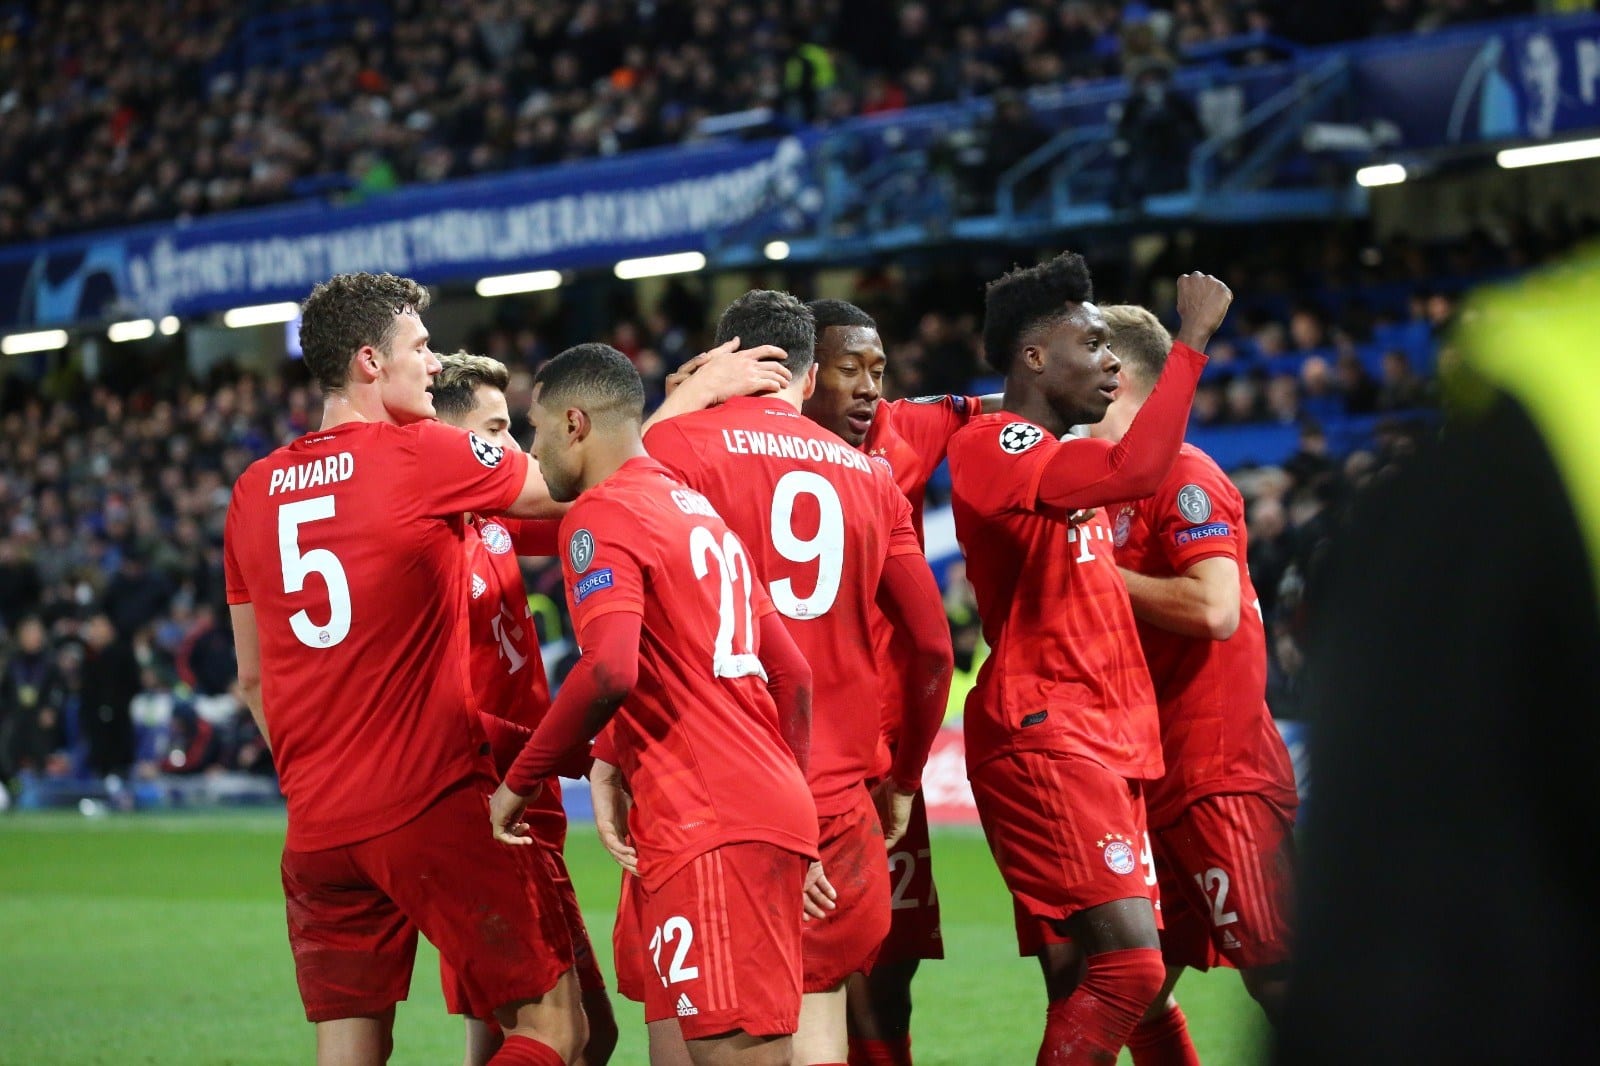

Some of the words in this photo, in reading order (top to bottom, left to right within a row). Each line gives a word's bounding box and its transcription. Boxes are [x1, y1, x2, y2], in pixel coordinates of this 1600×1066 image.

[268, 451, 354, 496] PAVARD
[722, 429, 872, 475] LEWANDOWSKI
[769, 470, 845, 621] 9
[1191, 527, 1229, 541] RESPECT
[278, 494, 352, 648] 5
[579, 572, 612, 594] RESPECT
